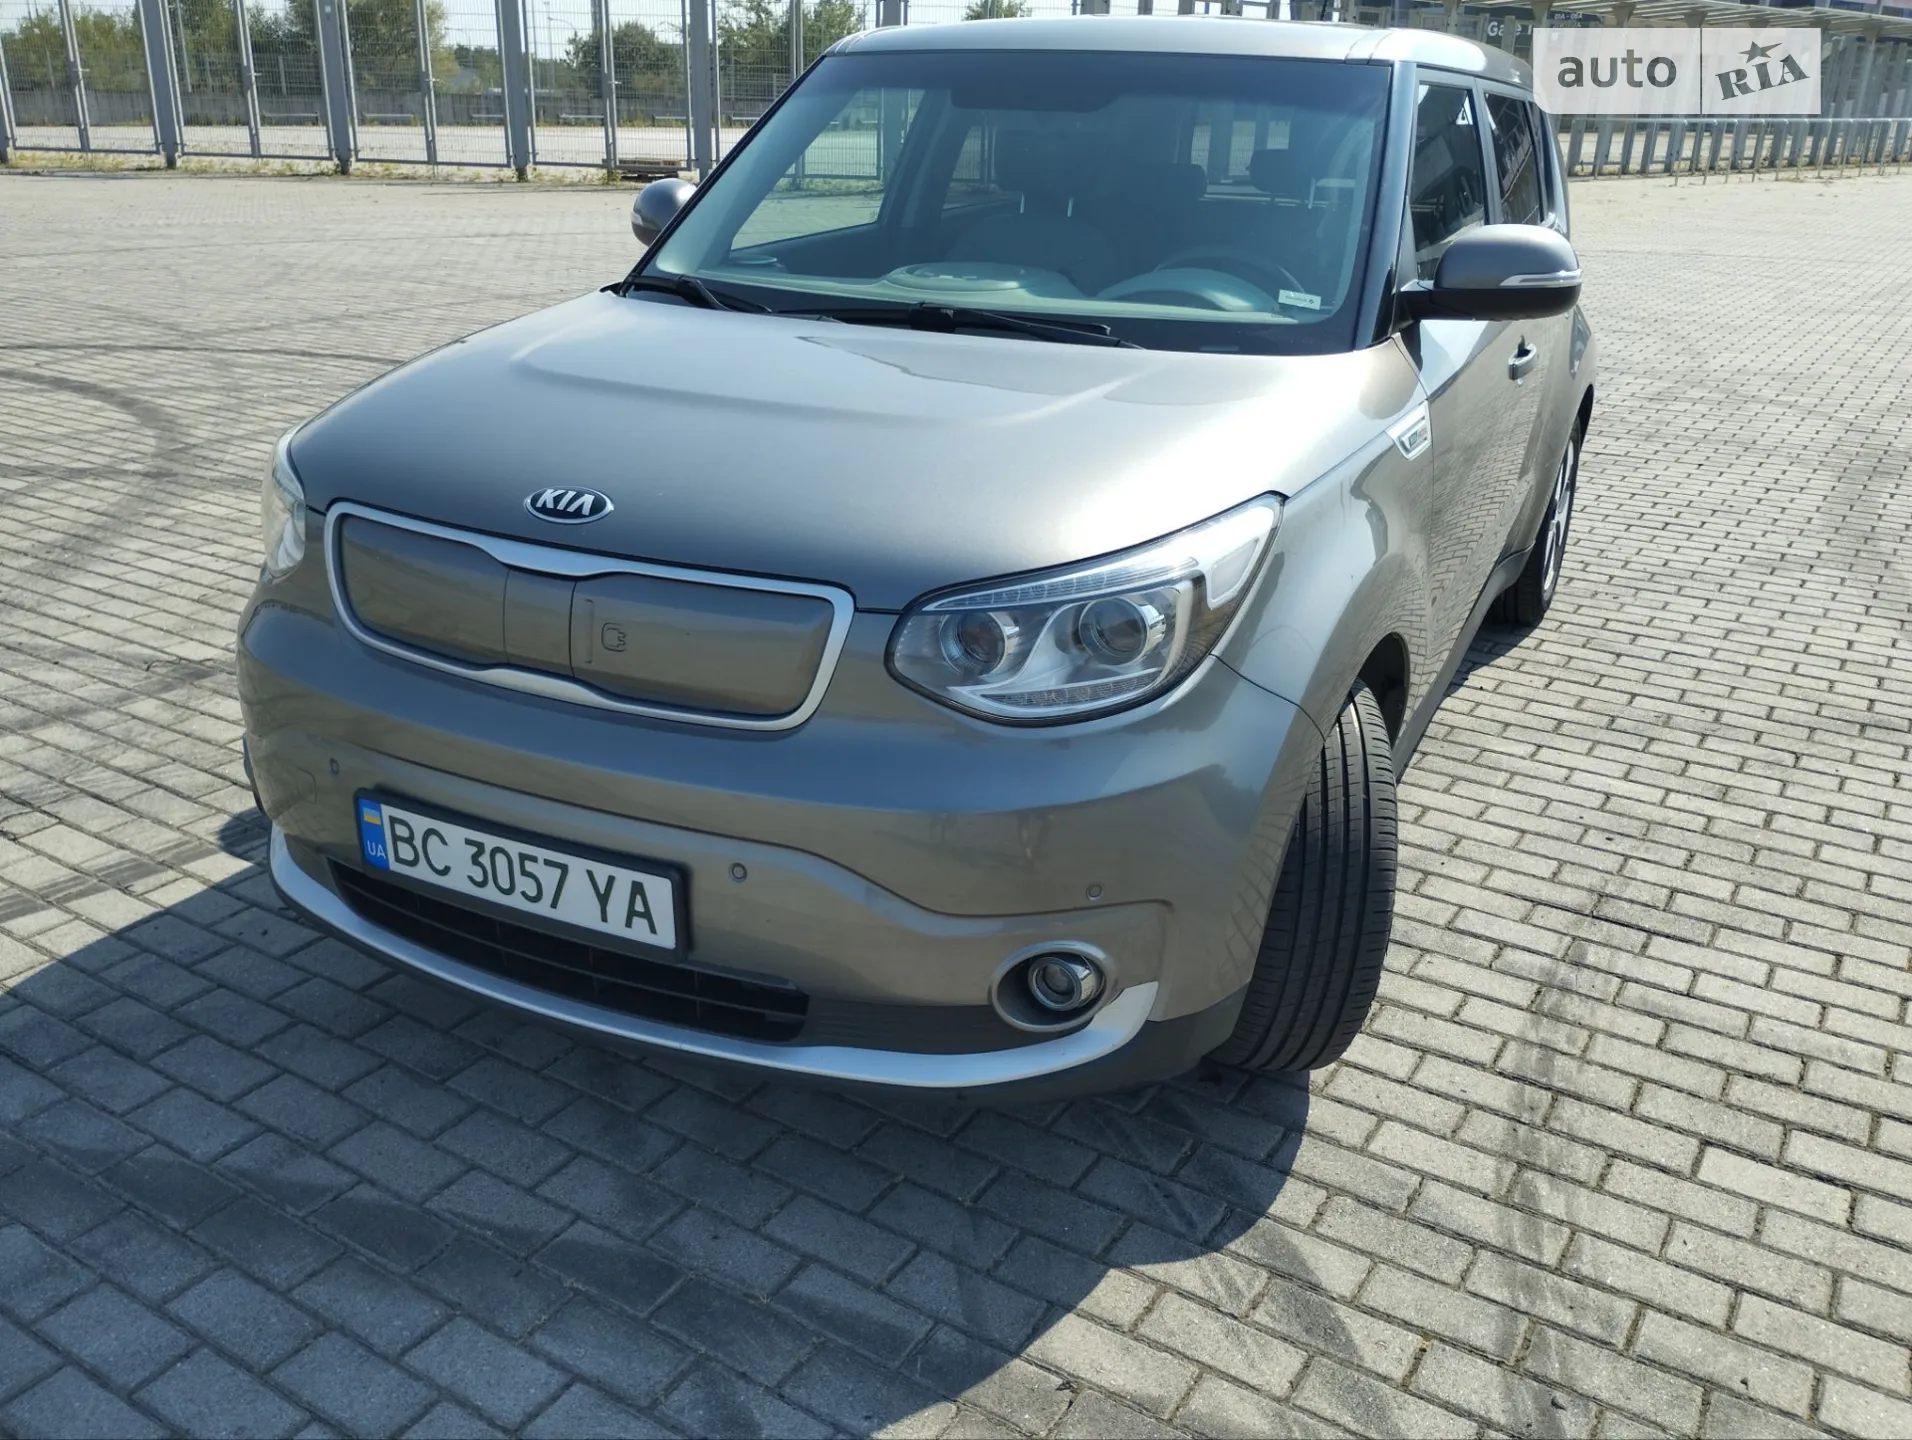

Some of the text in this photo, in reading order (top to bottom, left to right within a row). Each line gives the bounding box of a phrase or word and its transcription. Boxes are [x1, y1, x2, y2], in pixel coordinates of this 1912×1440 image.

[1487, 21, 1522, 37] Gae
[535, 488, 596, 516] KIA
[366, 840, 387, 860] UA
[388, 814, 658, 936] BC 3057 YA
